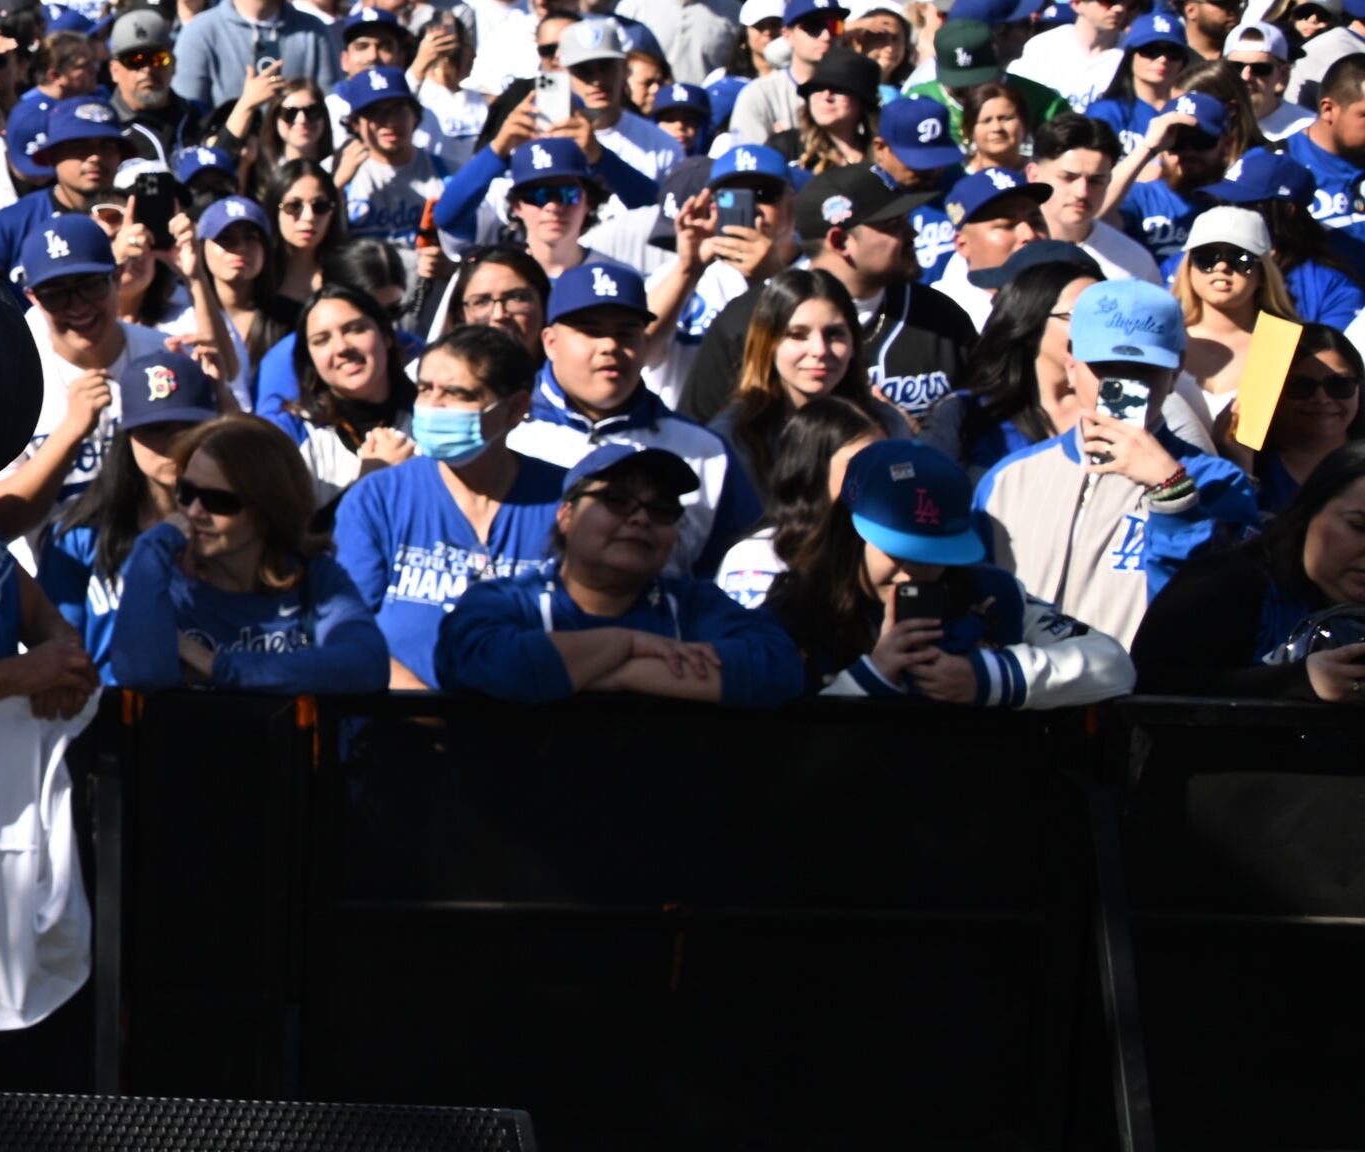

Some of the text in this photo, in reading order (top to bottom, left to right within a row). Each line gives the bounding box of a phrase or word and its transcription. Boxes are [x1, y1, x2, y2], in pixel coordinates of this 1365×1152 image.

[917, 119, 943, 142] D
[531, 143, 555, 170] LA
[45, 230, 71, 260] LA
[591, 267, 618, 297] LA
[915, 487, 940, 525] LA
